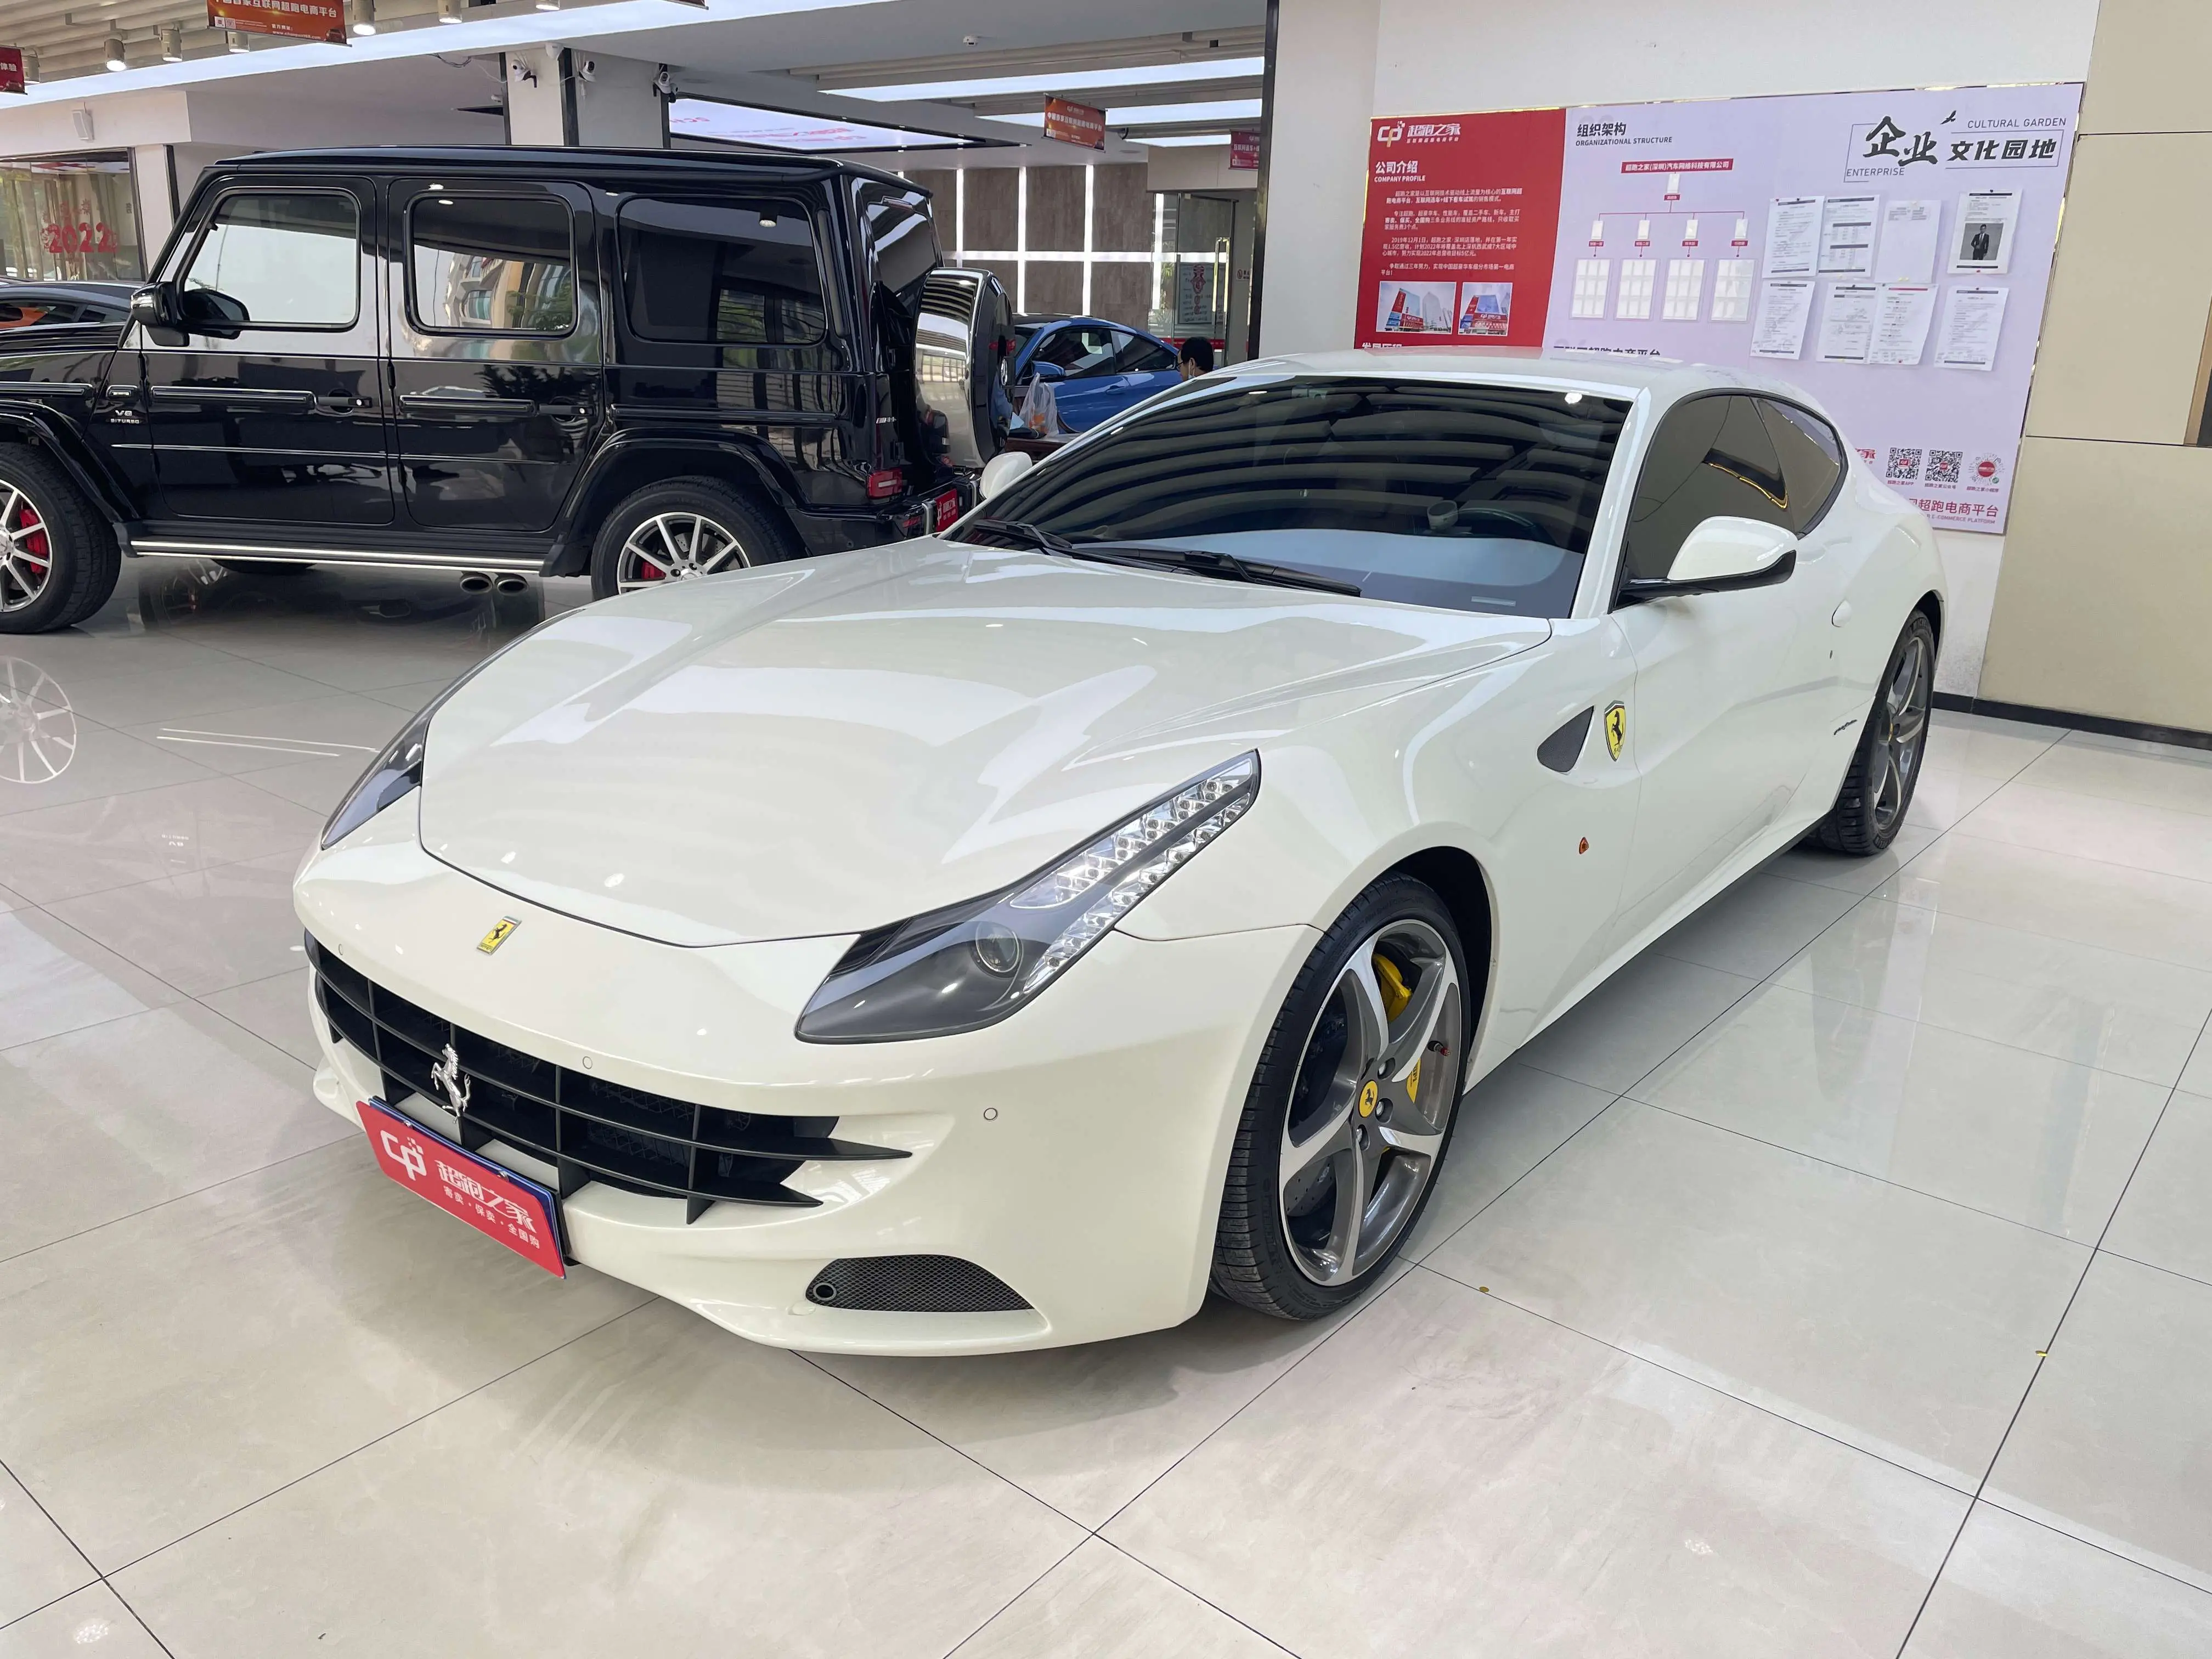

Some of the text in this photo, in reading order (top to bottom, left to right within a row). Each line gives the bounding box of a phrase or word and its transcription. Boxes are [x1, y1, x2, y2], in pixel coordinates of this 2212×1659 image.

[216, 0, 337, 18] 国首家互联网超跑电商平台
[1407, 123, 1461, 138] 超跑之家
[1577, 122, 1626, 137] 组织架构
[1967, 117, 2067, 129] CULTURAL GARDEN
[1863, 115, 2057, 167] 企业 文化园地
[1375, 160, 1419, 174] 公司介绍
[1846, 167, 1905, 177] ENTERPRISE
[434, 1160, 537, 1234] 超跑之家
